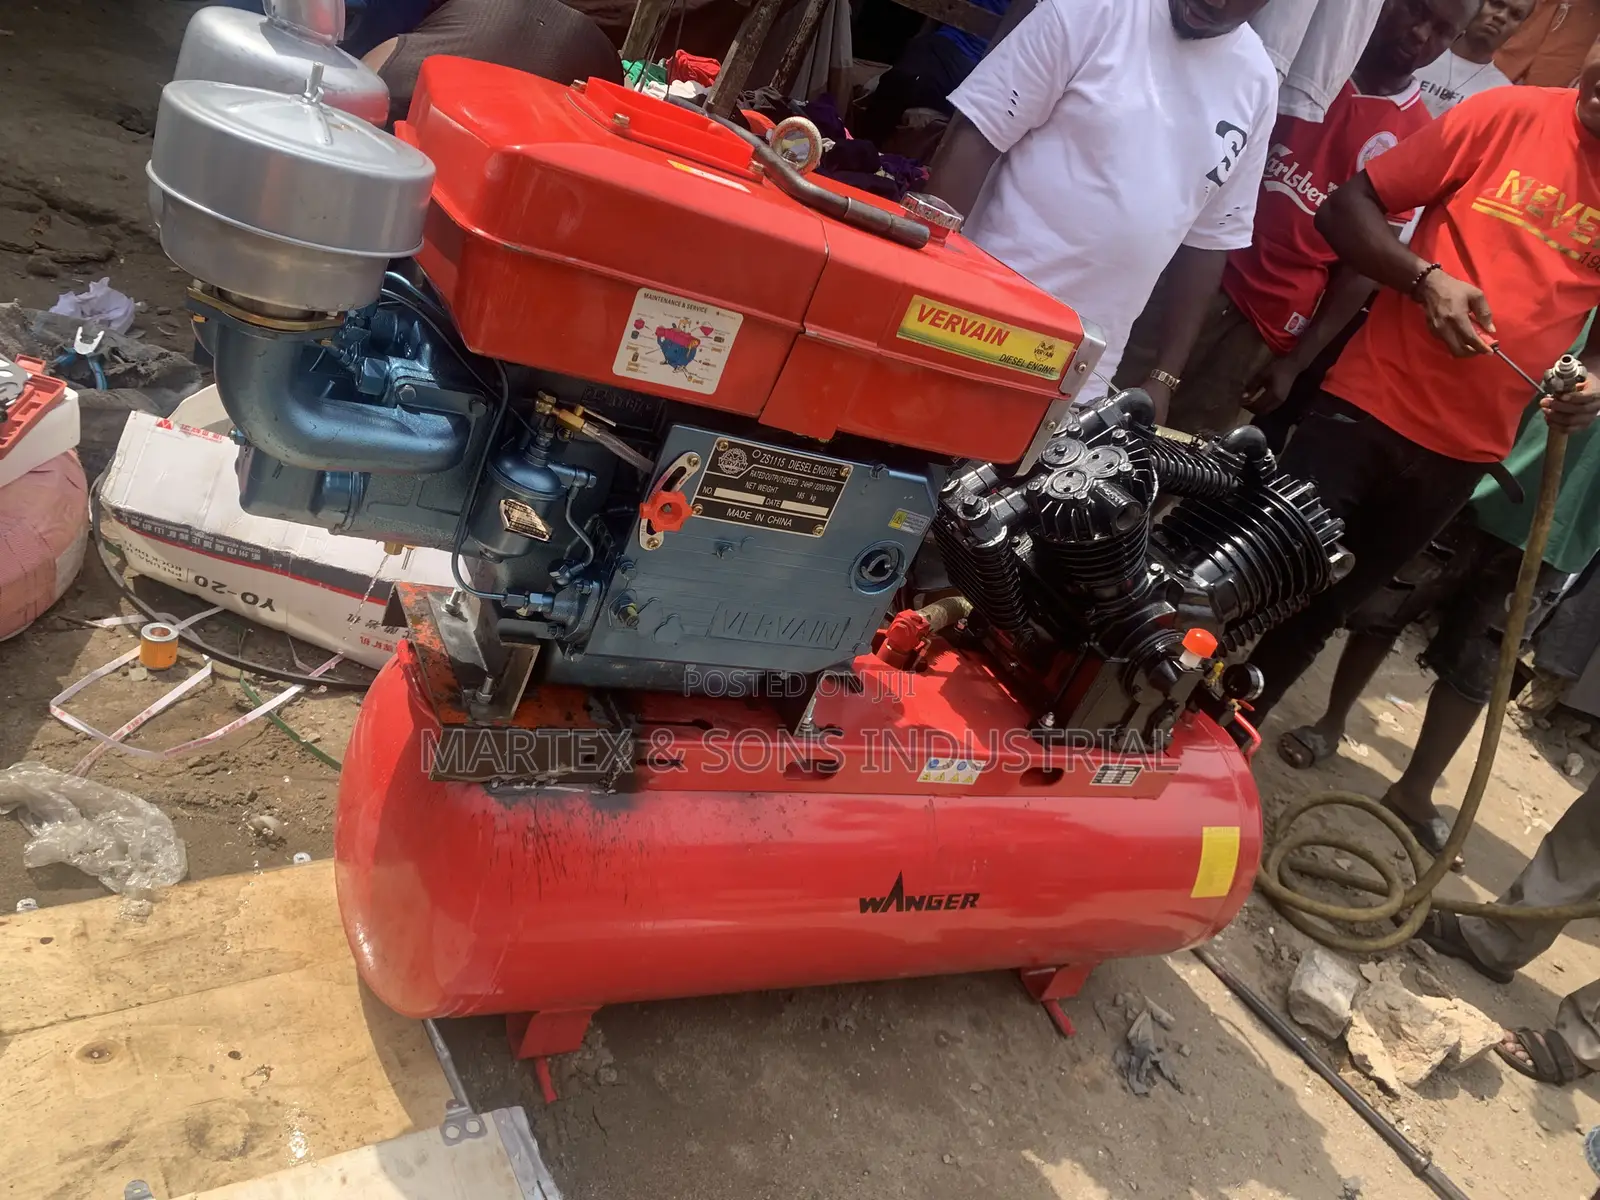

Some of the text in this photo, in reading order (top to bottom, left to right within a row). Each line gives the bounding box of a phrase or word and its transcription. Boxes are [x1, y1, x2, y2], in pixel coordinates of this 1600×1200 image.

[1495, 169, 1600, 249] NEVE
[643, 292, 681, 308] MAINTENANCE
[686, 302, 708, 314] SERVICE
[916, 303, 1011, 347] VERVAIN
[999, 354, 1056, 374] DIESEL ENGINE
[718, 456, 749, 471] VERVAIN
[760, 453, 839, 478] ZS1115 DIESEL ENGINE
[702, 486, 782, 508] NO. DATE
[745, 481, 756, 490] NET
[757, 483, 779, 493] WEIGHT
[809, 493, 816, 503] kg
[726, 508, 793, 527] MADE IN CHINA
[858, 870, 981, 914] WANGER
